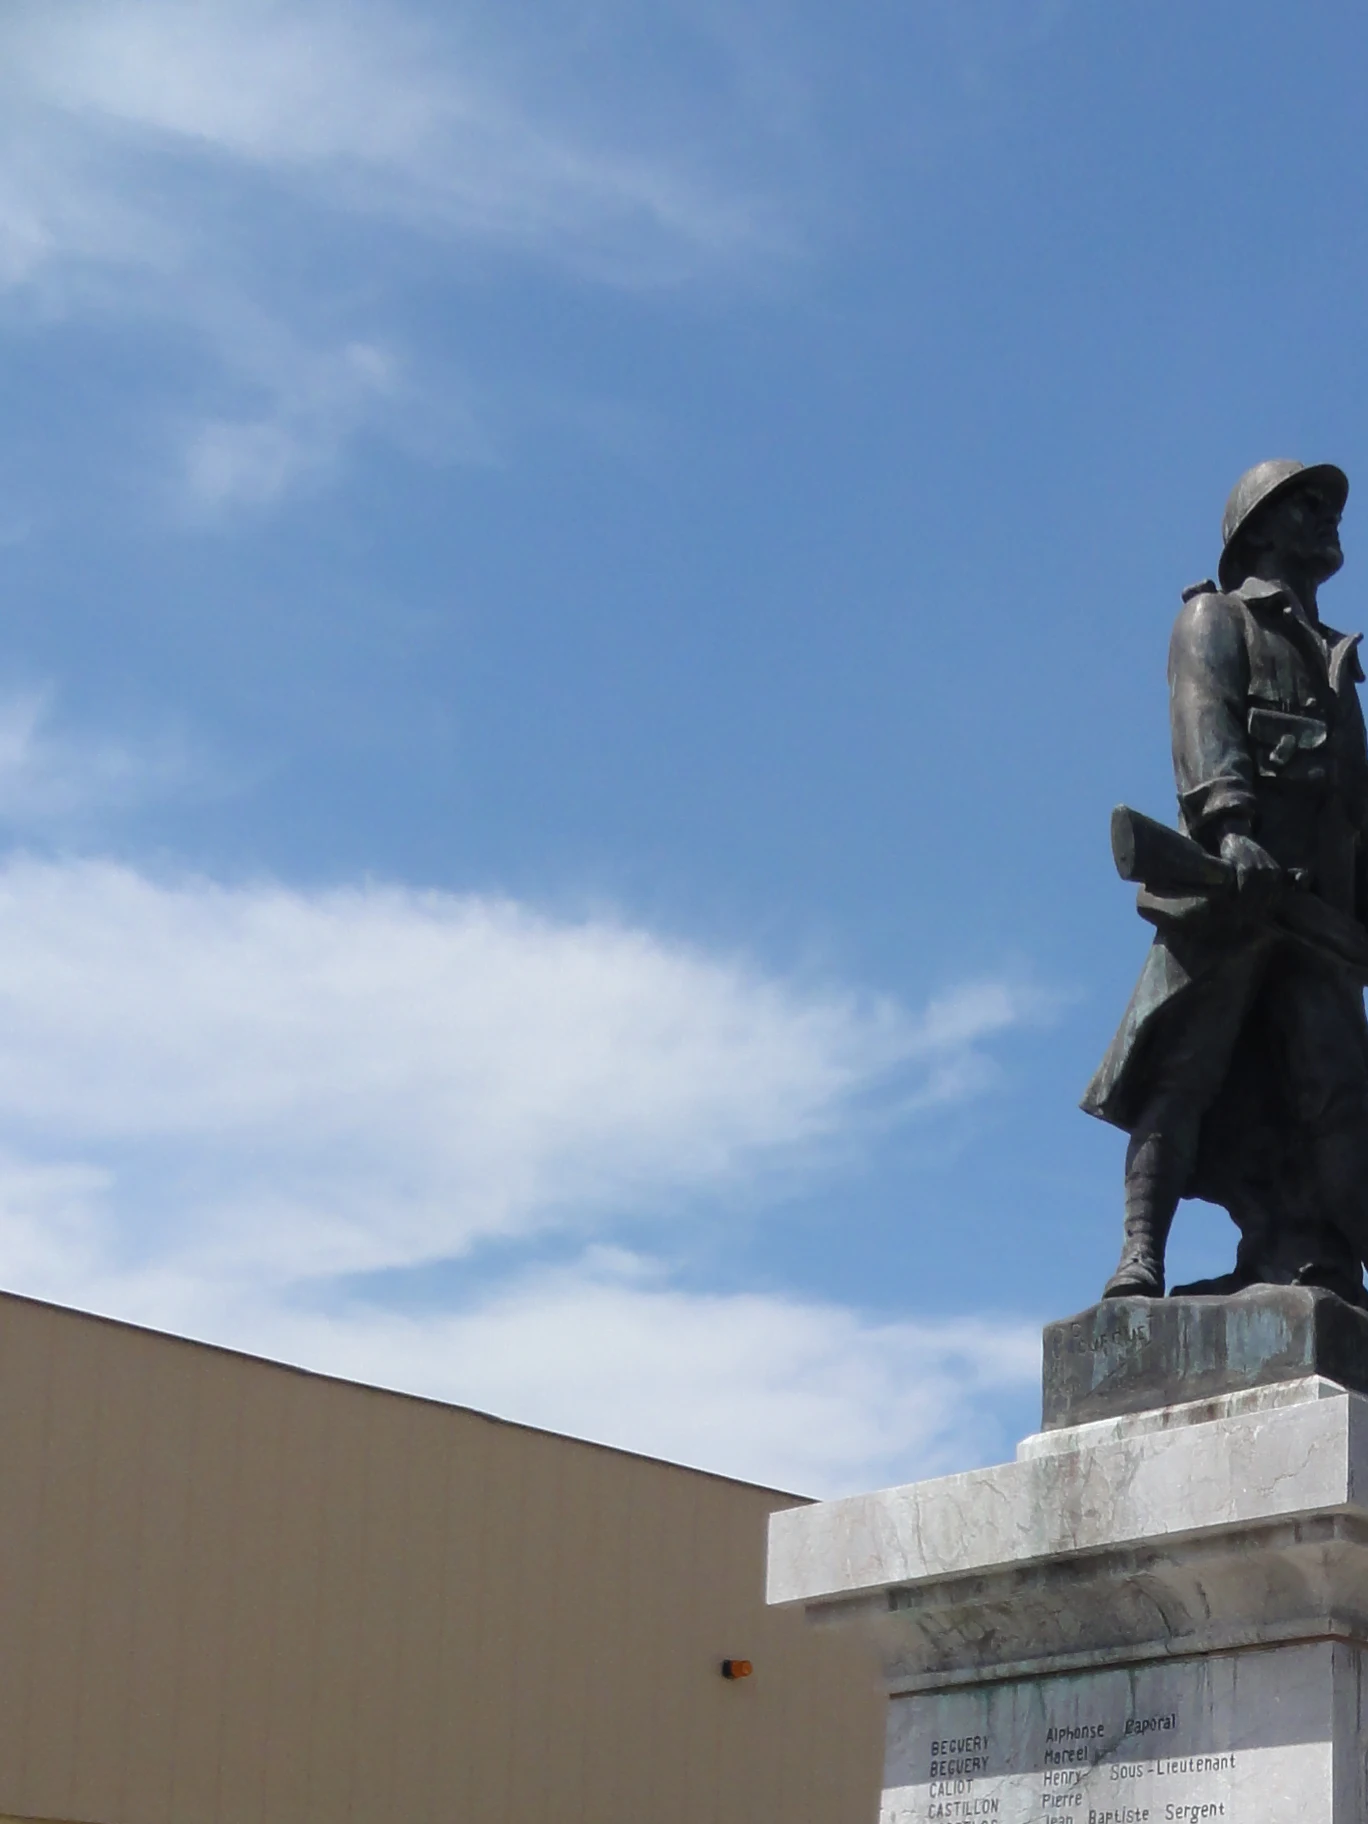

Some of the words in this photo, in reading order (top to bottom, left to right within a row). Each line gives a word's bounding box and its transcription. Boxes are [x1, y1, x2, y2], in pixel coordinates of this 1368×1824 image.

[931, 1735, 989, 1756] BEGUERY
[1045, 1723, 1105, 1744] Alphonse
[1124, 1713, 1176, 1736] Caporal
[930, 1756, 989, 1777] BEGUERY
[929, 1779, 973, 1798] CALIOT
[1043, 1769, 1082, 1787] Henry
[928, 1799, 999, 1819] CASTILLON
[1042, 1791, 1083, 1809] Pierre
[1165, 1802, 1226, 1824] Sergent
